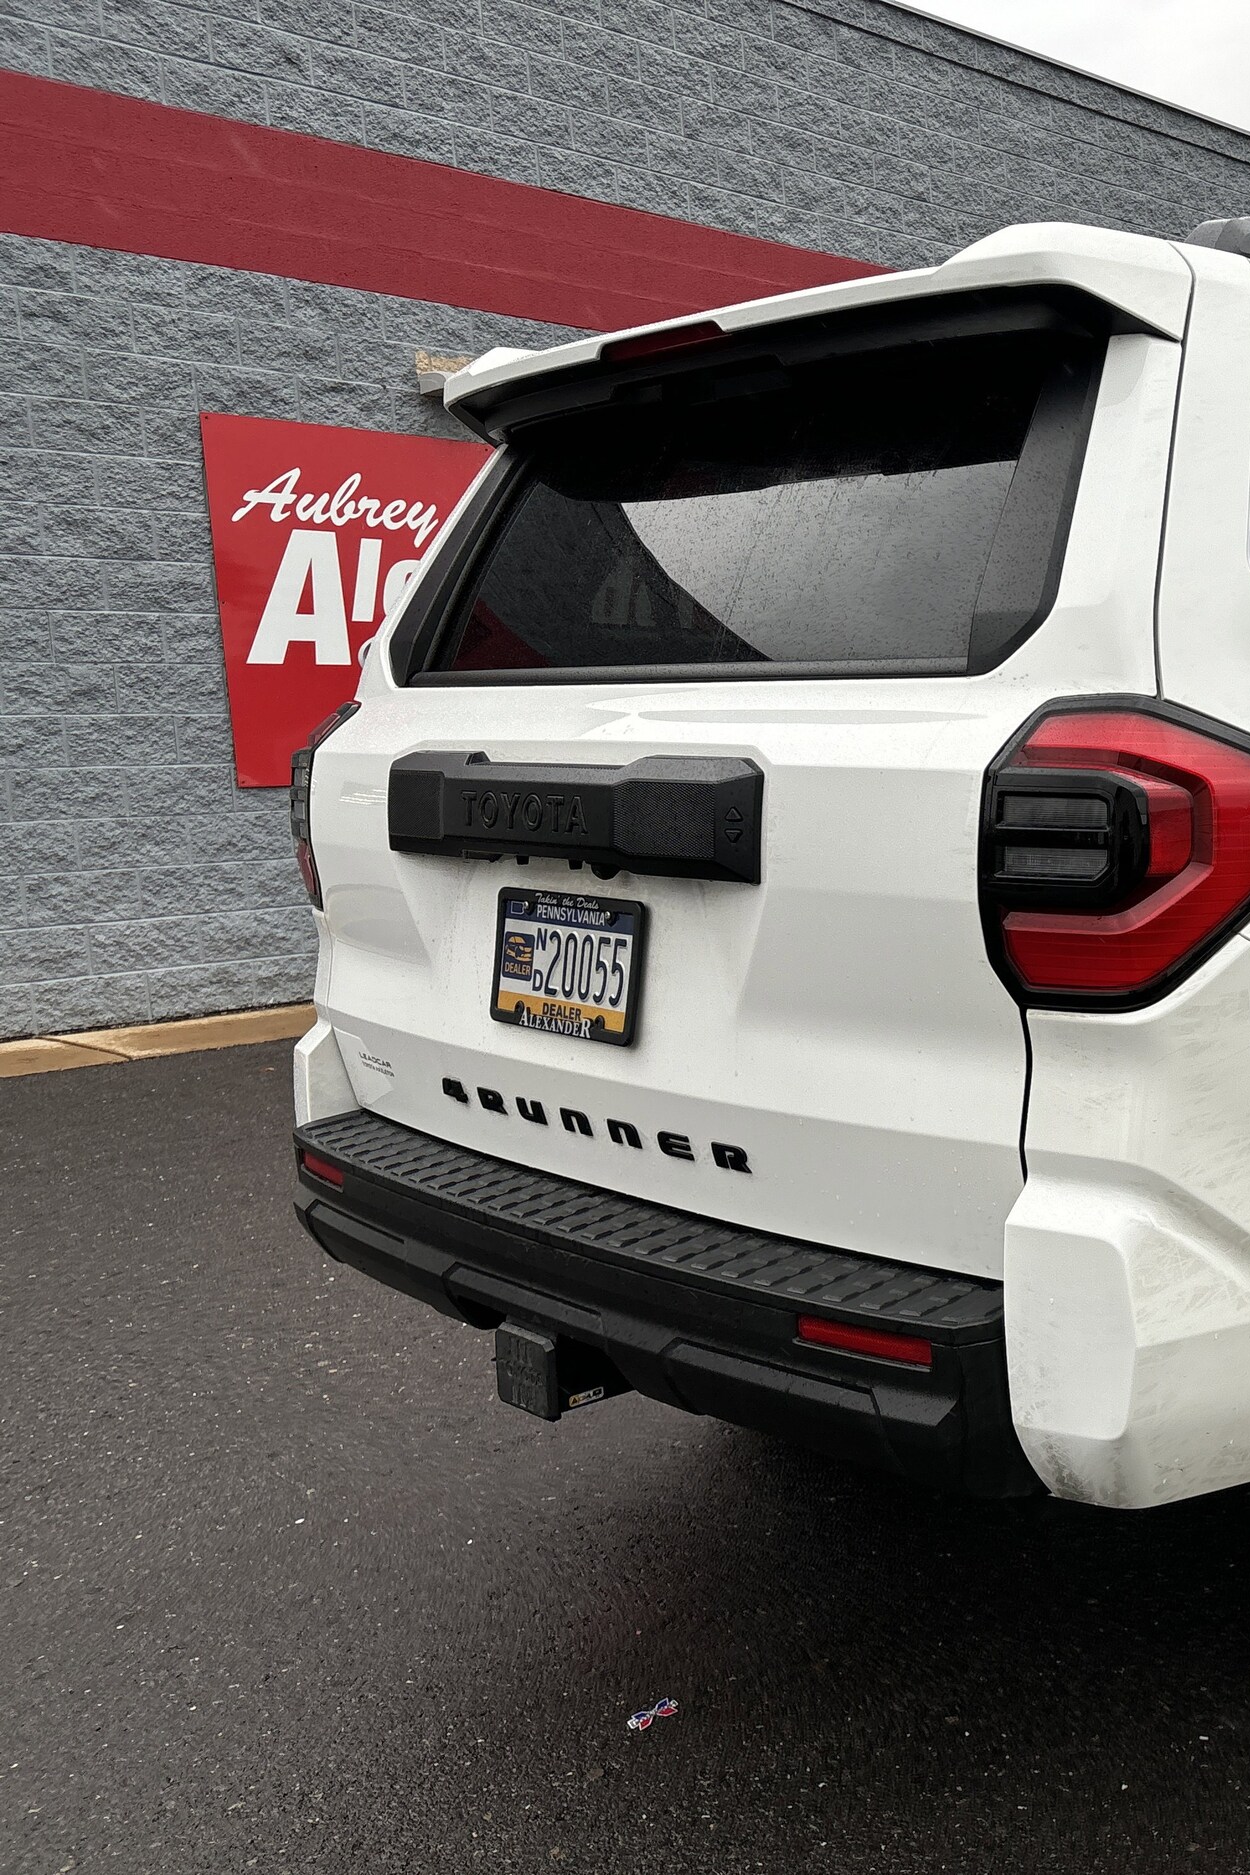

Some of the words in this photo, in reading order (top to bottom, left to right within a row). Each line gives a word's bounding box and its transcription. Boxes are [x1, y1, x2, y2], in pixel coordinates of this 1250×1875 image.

[231, 467, 440, 548] Aubrey
[461, 789, 589, 836] TOYOTA
[535, 892, 560, 905] Takin'
[562, 896, 574, 907] the
[576, 897, 599, 910] Deals
[536, 904, 606, 927] PENNSYLVANIA
[504, 961, 532, 976] DEALER
[543, 929, 628, 1007] 20055
[519, 1010, 591, 1039] ALEXANDER
[542, 1002, 582, 1021] DEALER
[441, 1076, 753, 1174] 4RUNNER
